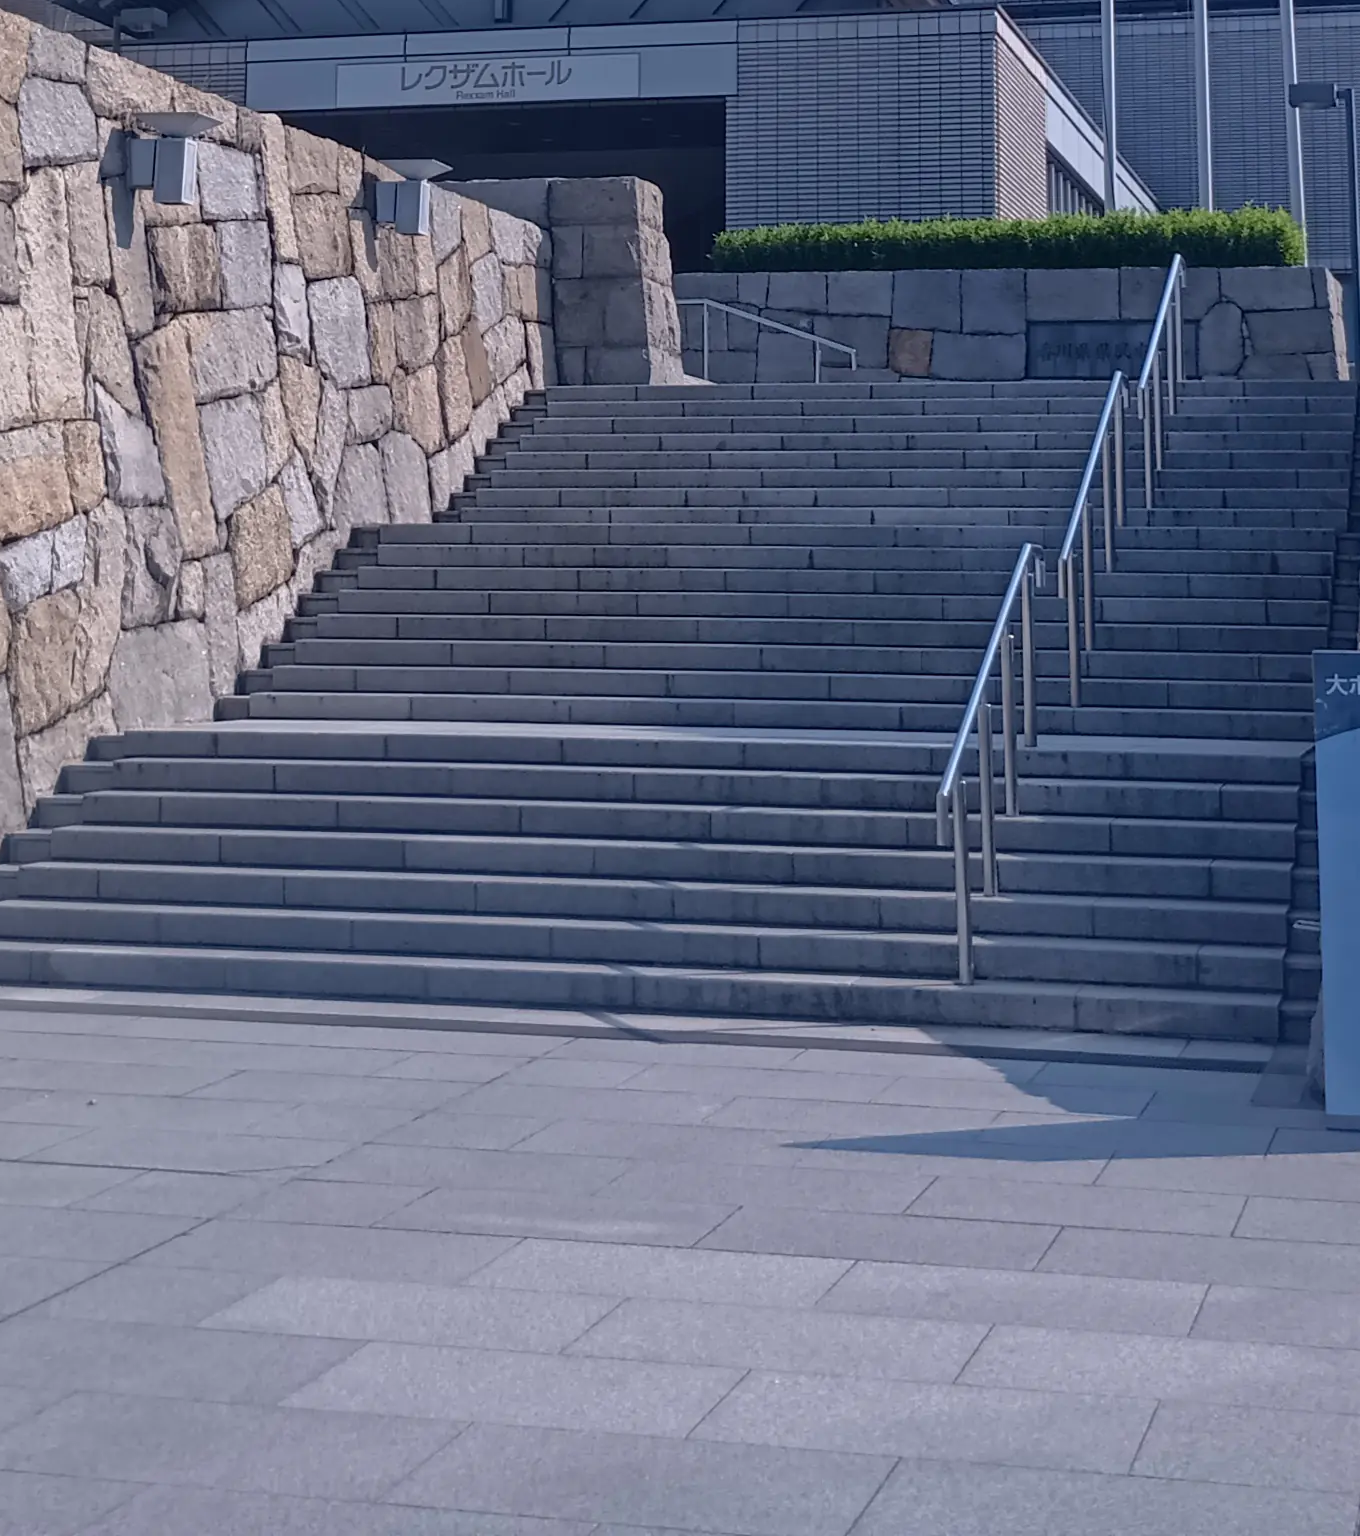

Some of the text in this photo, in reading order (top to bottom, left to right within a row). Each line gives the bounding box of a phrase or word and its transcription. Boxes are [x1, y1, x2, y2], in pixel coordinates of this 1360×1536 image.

[400, 59, 573, 91] レクザムホール
[496, 88, 516, 99] Hall
